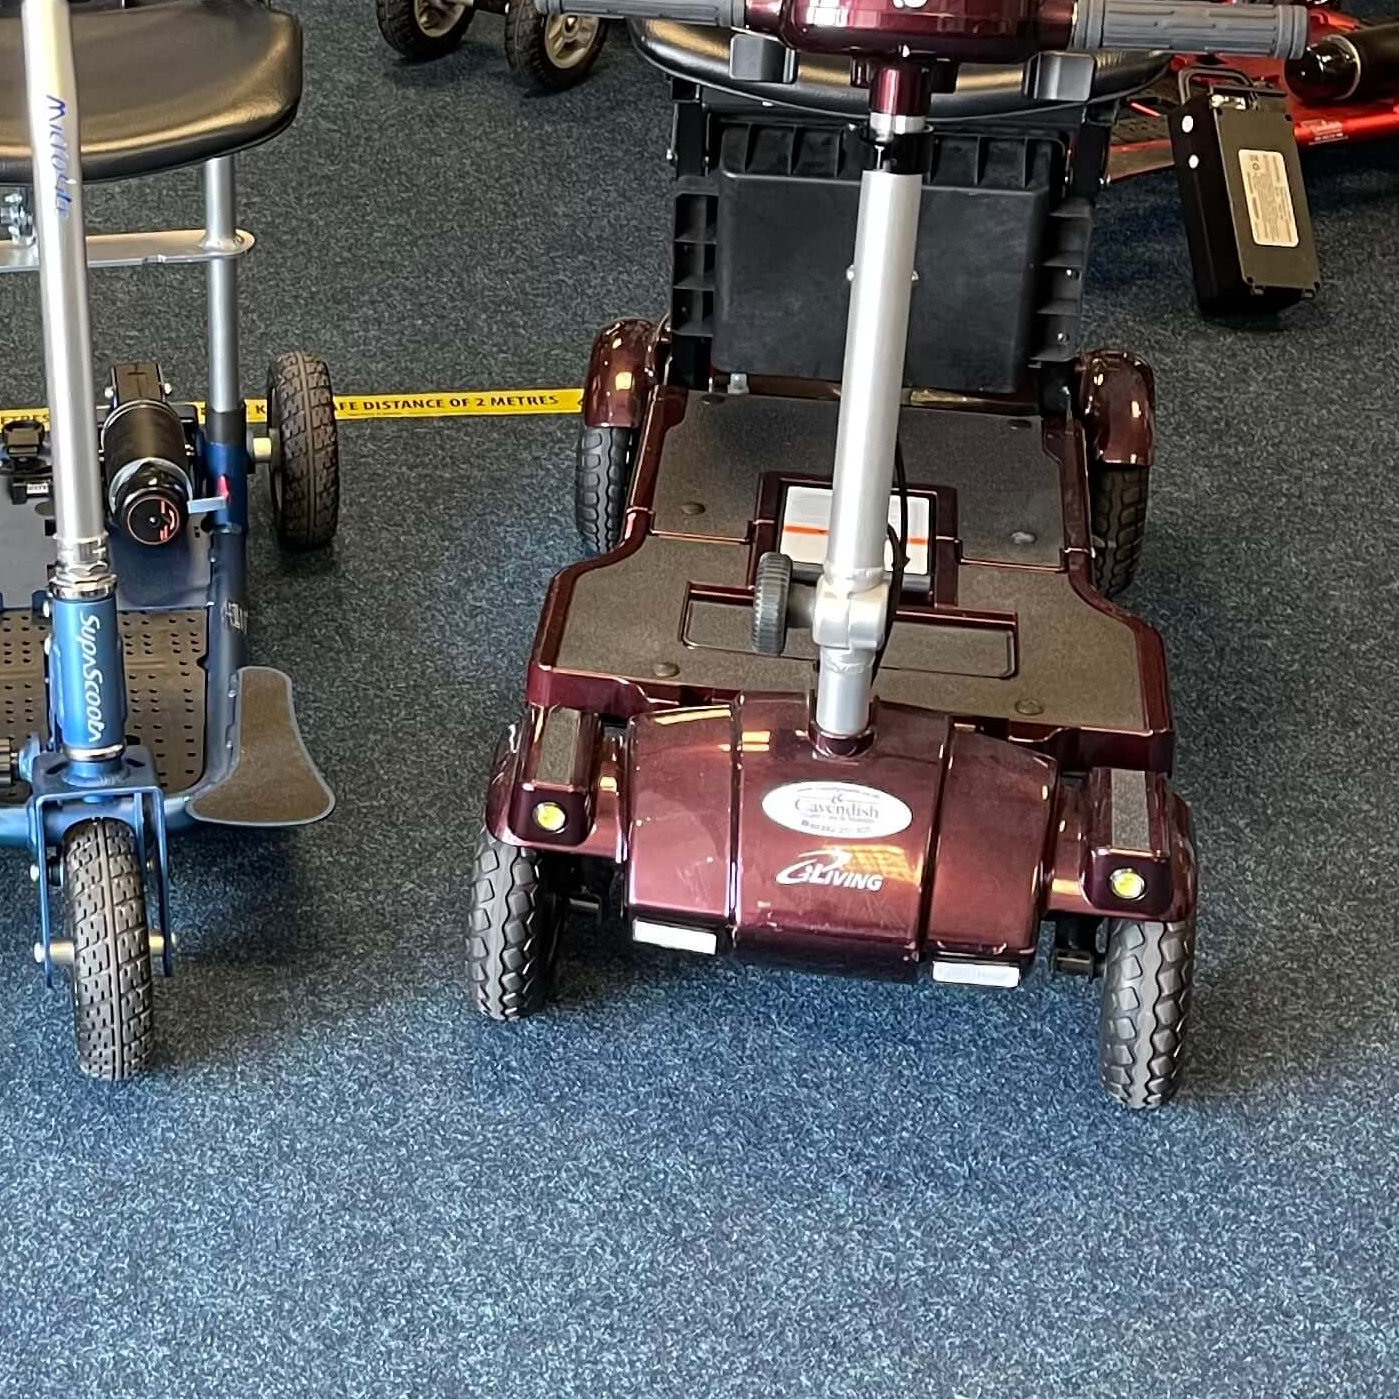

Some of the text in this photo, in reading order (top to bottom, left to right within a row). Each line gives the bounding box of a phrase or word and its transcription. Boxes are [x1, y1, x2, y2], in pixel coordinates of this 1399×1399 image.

[363, 399, 443, 411] DISTANCE
[450, 398, 472, 408] OF
[476, 397, 486, 407] 2
[490, 395, 559, 408] METRES
[794, 798, 880, 820] Cavendish
